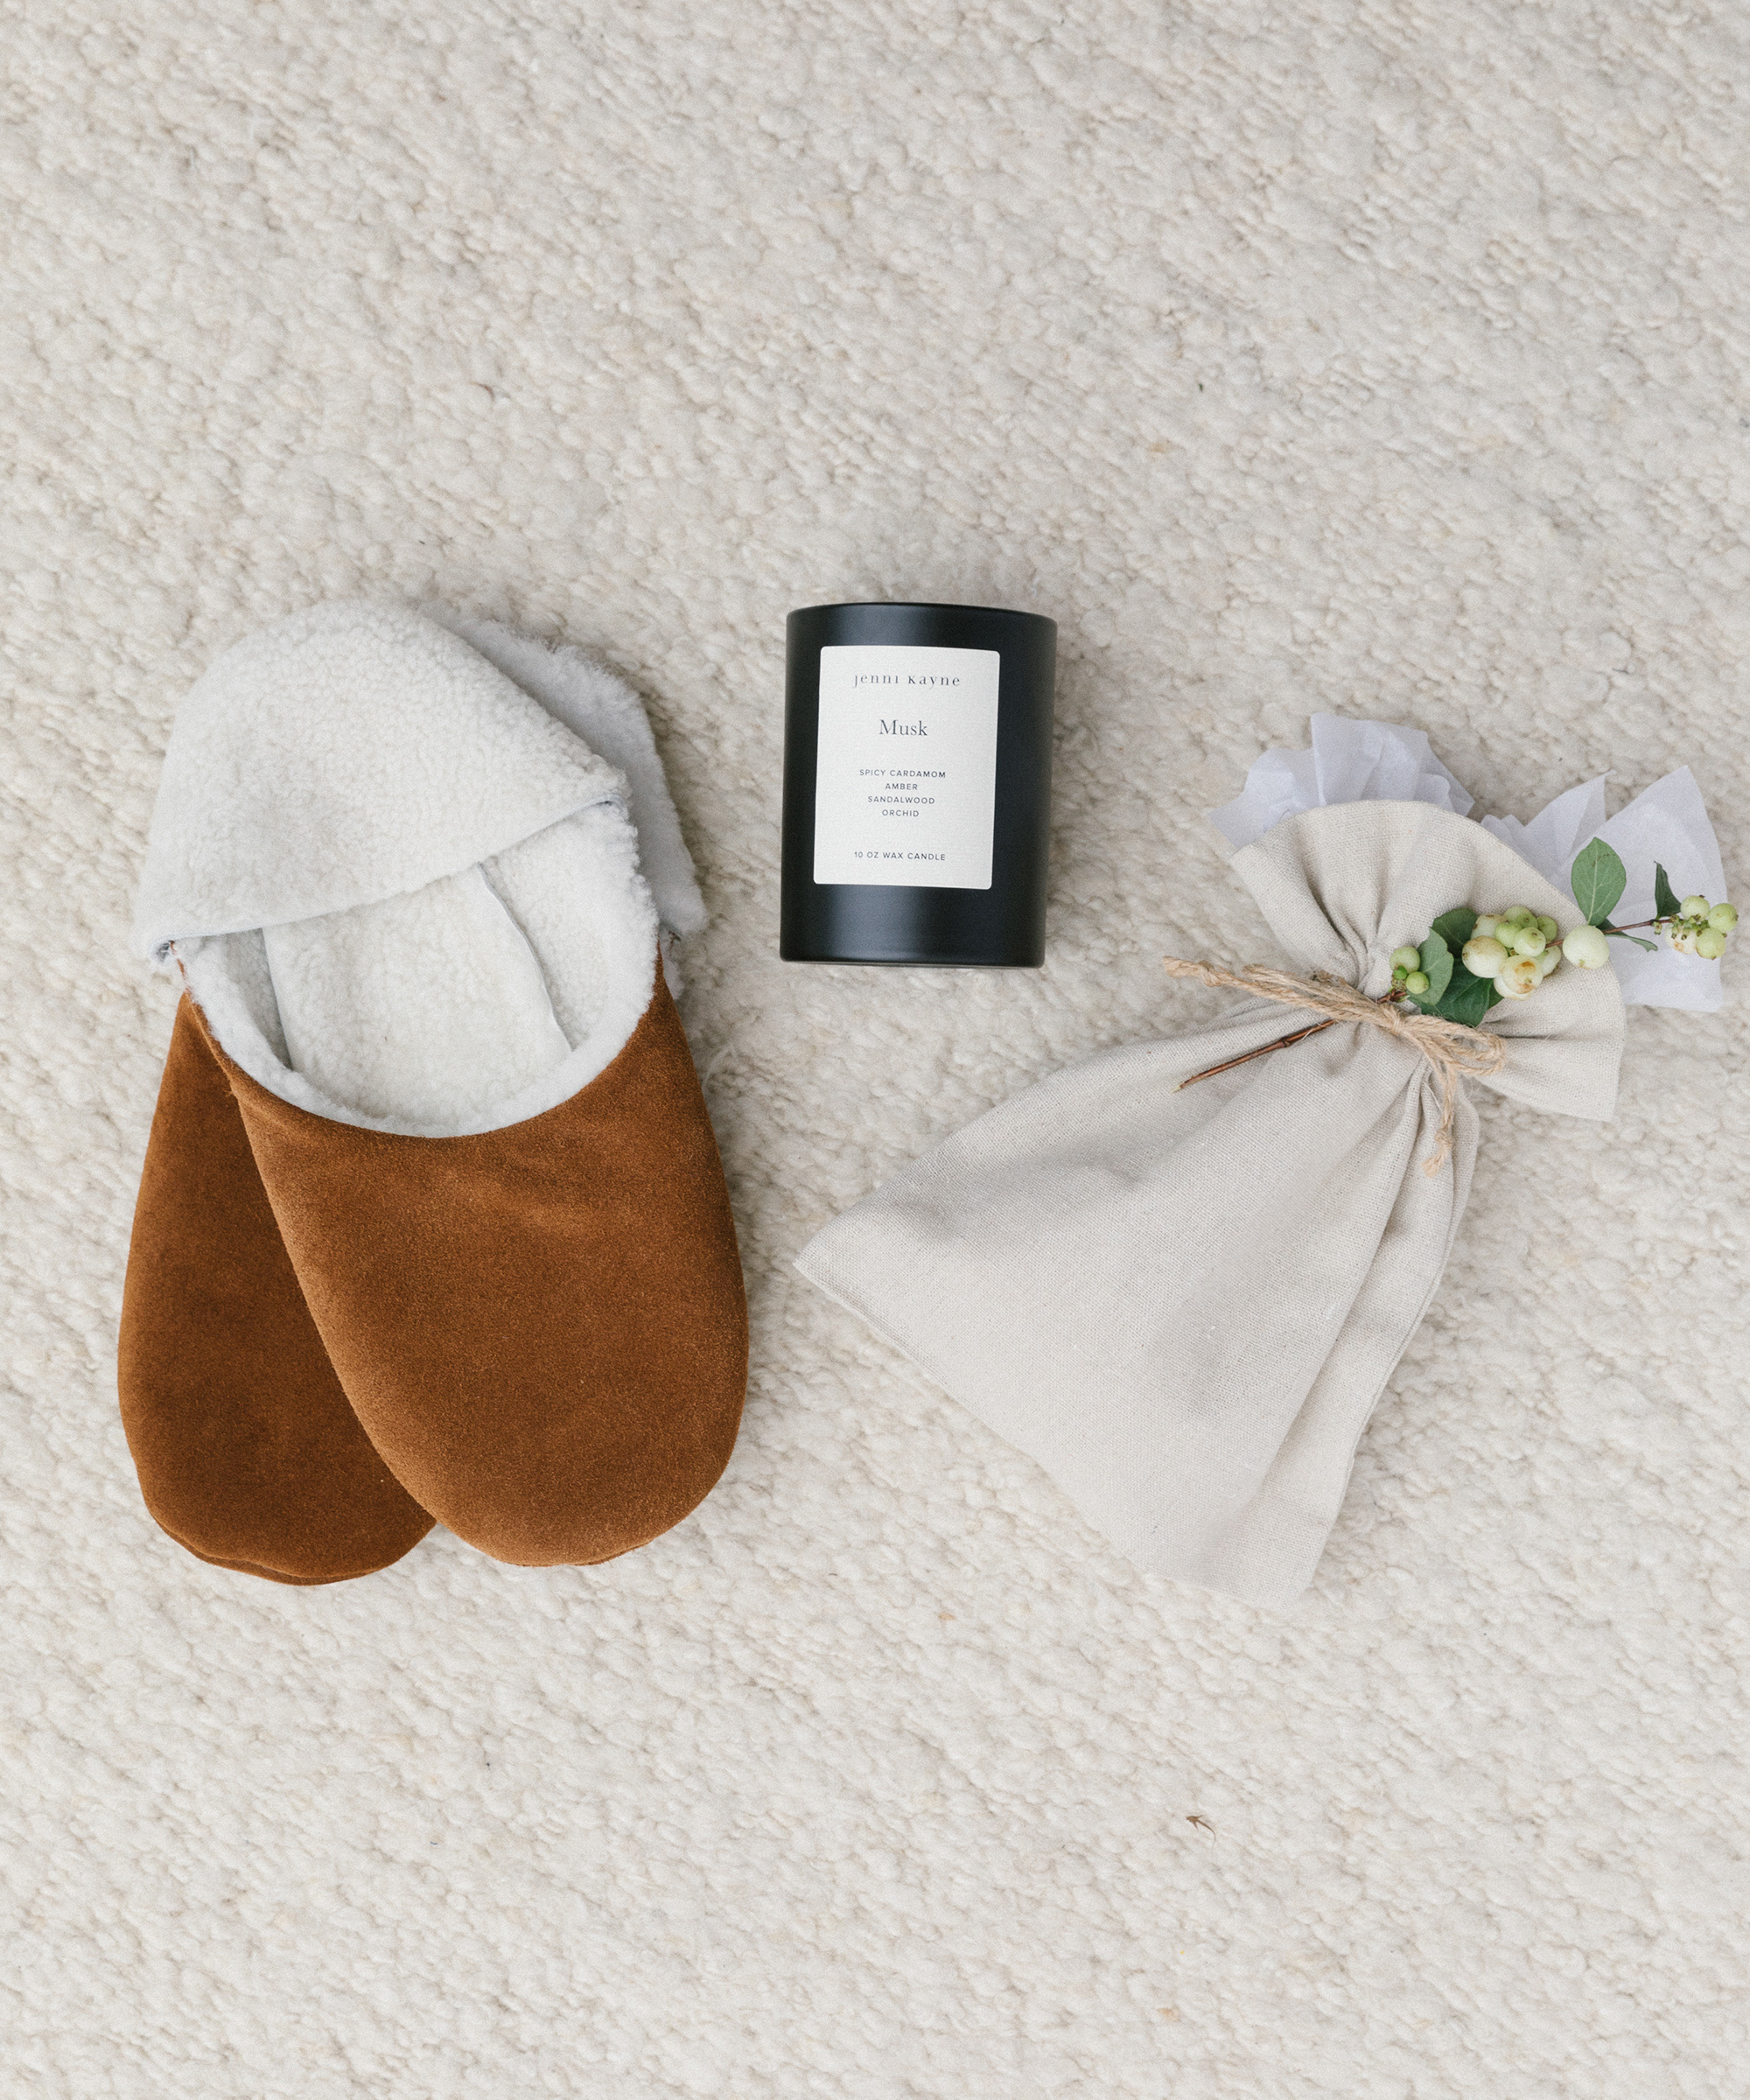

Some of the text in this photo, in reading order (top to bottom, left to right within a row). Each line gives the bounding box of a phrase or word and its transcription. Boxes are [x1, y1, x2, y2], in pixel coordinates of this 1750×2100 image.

[878, 718, 928, 736] Musk
[859, 768, 947, 779] SPICY CARDAMOM
[885, 782, 919, 791] AMBER
[867, 795, 935, 805] SANDALWOOD
[881, 808, 920, 817] ORCHID
[866, 850, 879, 859] OZ
[882, 851, 904, 860] WAX
[906, 851, 946, 861] CANDLE
